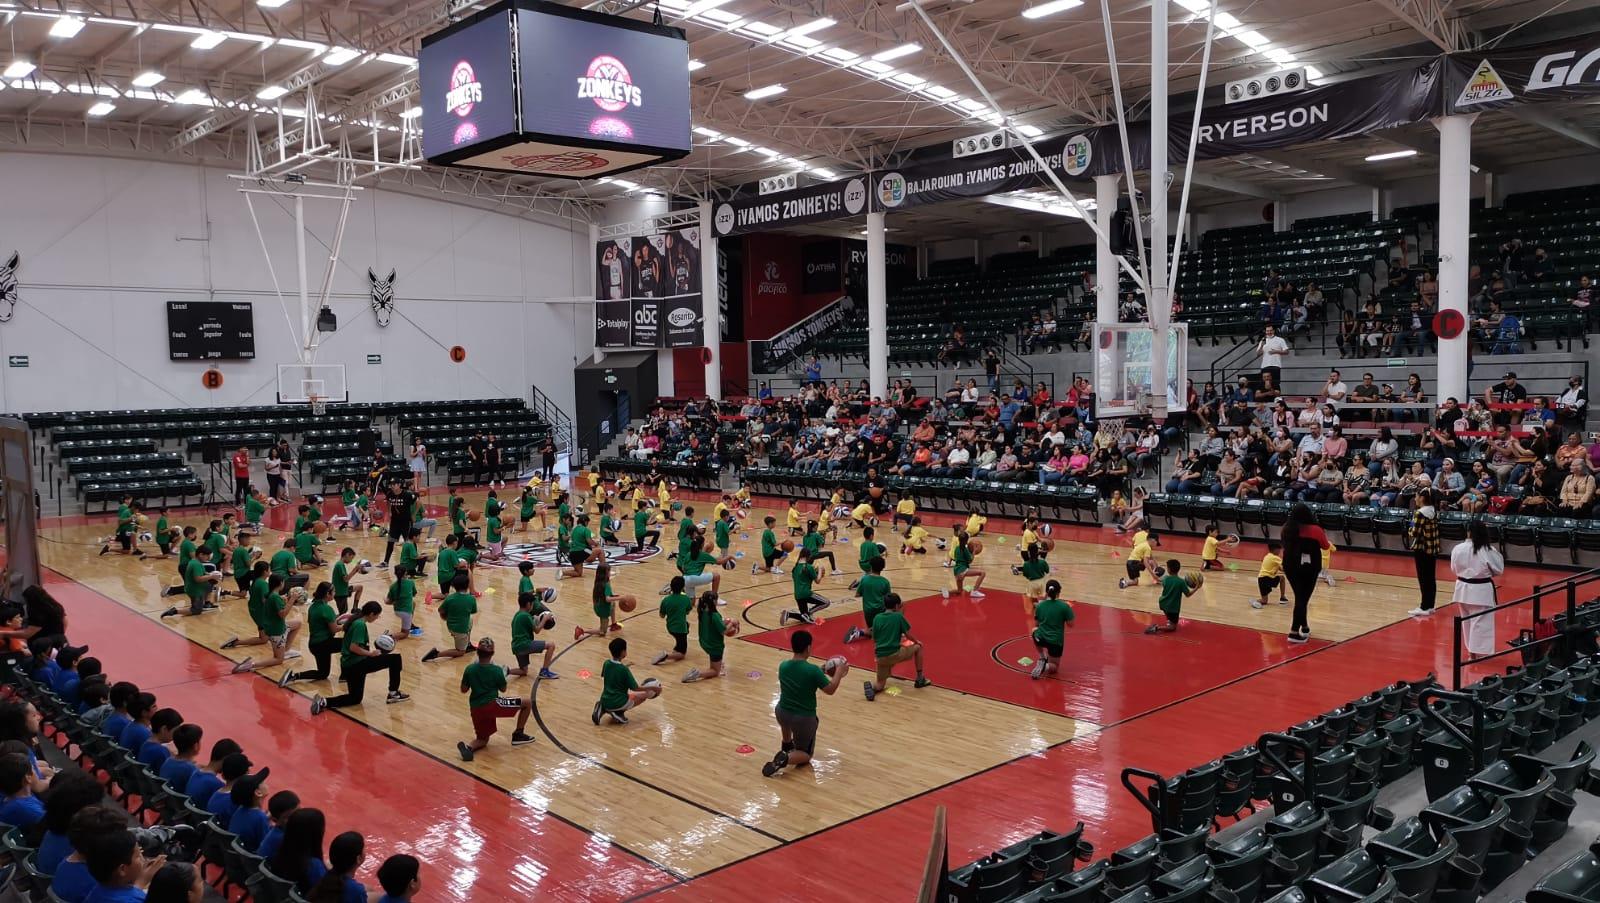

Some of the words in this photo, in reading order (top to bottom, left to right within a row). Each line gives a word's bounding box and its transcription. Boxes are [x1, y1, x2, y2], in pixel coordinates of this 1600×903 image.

[446, 82, 482, 113] ZONKEYS
[577, 77, 641, 107] ZONKEYS
[1198, 104, 1328, 144] RYERSON
[907, 174, 963, 195] BAJAROUND
[966, 165, 1006, 185] ¡VAMOS
[737, 203, 779, 226] ¡VAMOS
[783, 192, 841, 219] ZONKEYS!
[607, 319, 629, 329] Totalplay
[635, 304, 657, 324] abc
[1441, 313, 1457, 337] C
[454, 346, 463, 362] C
[208, 369, 219, 389] B
